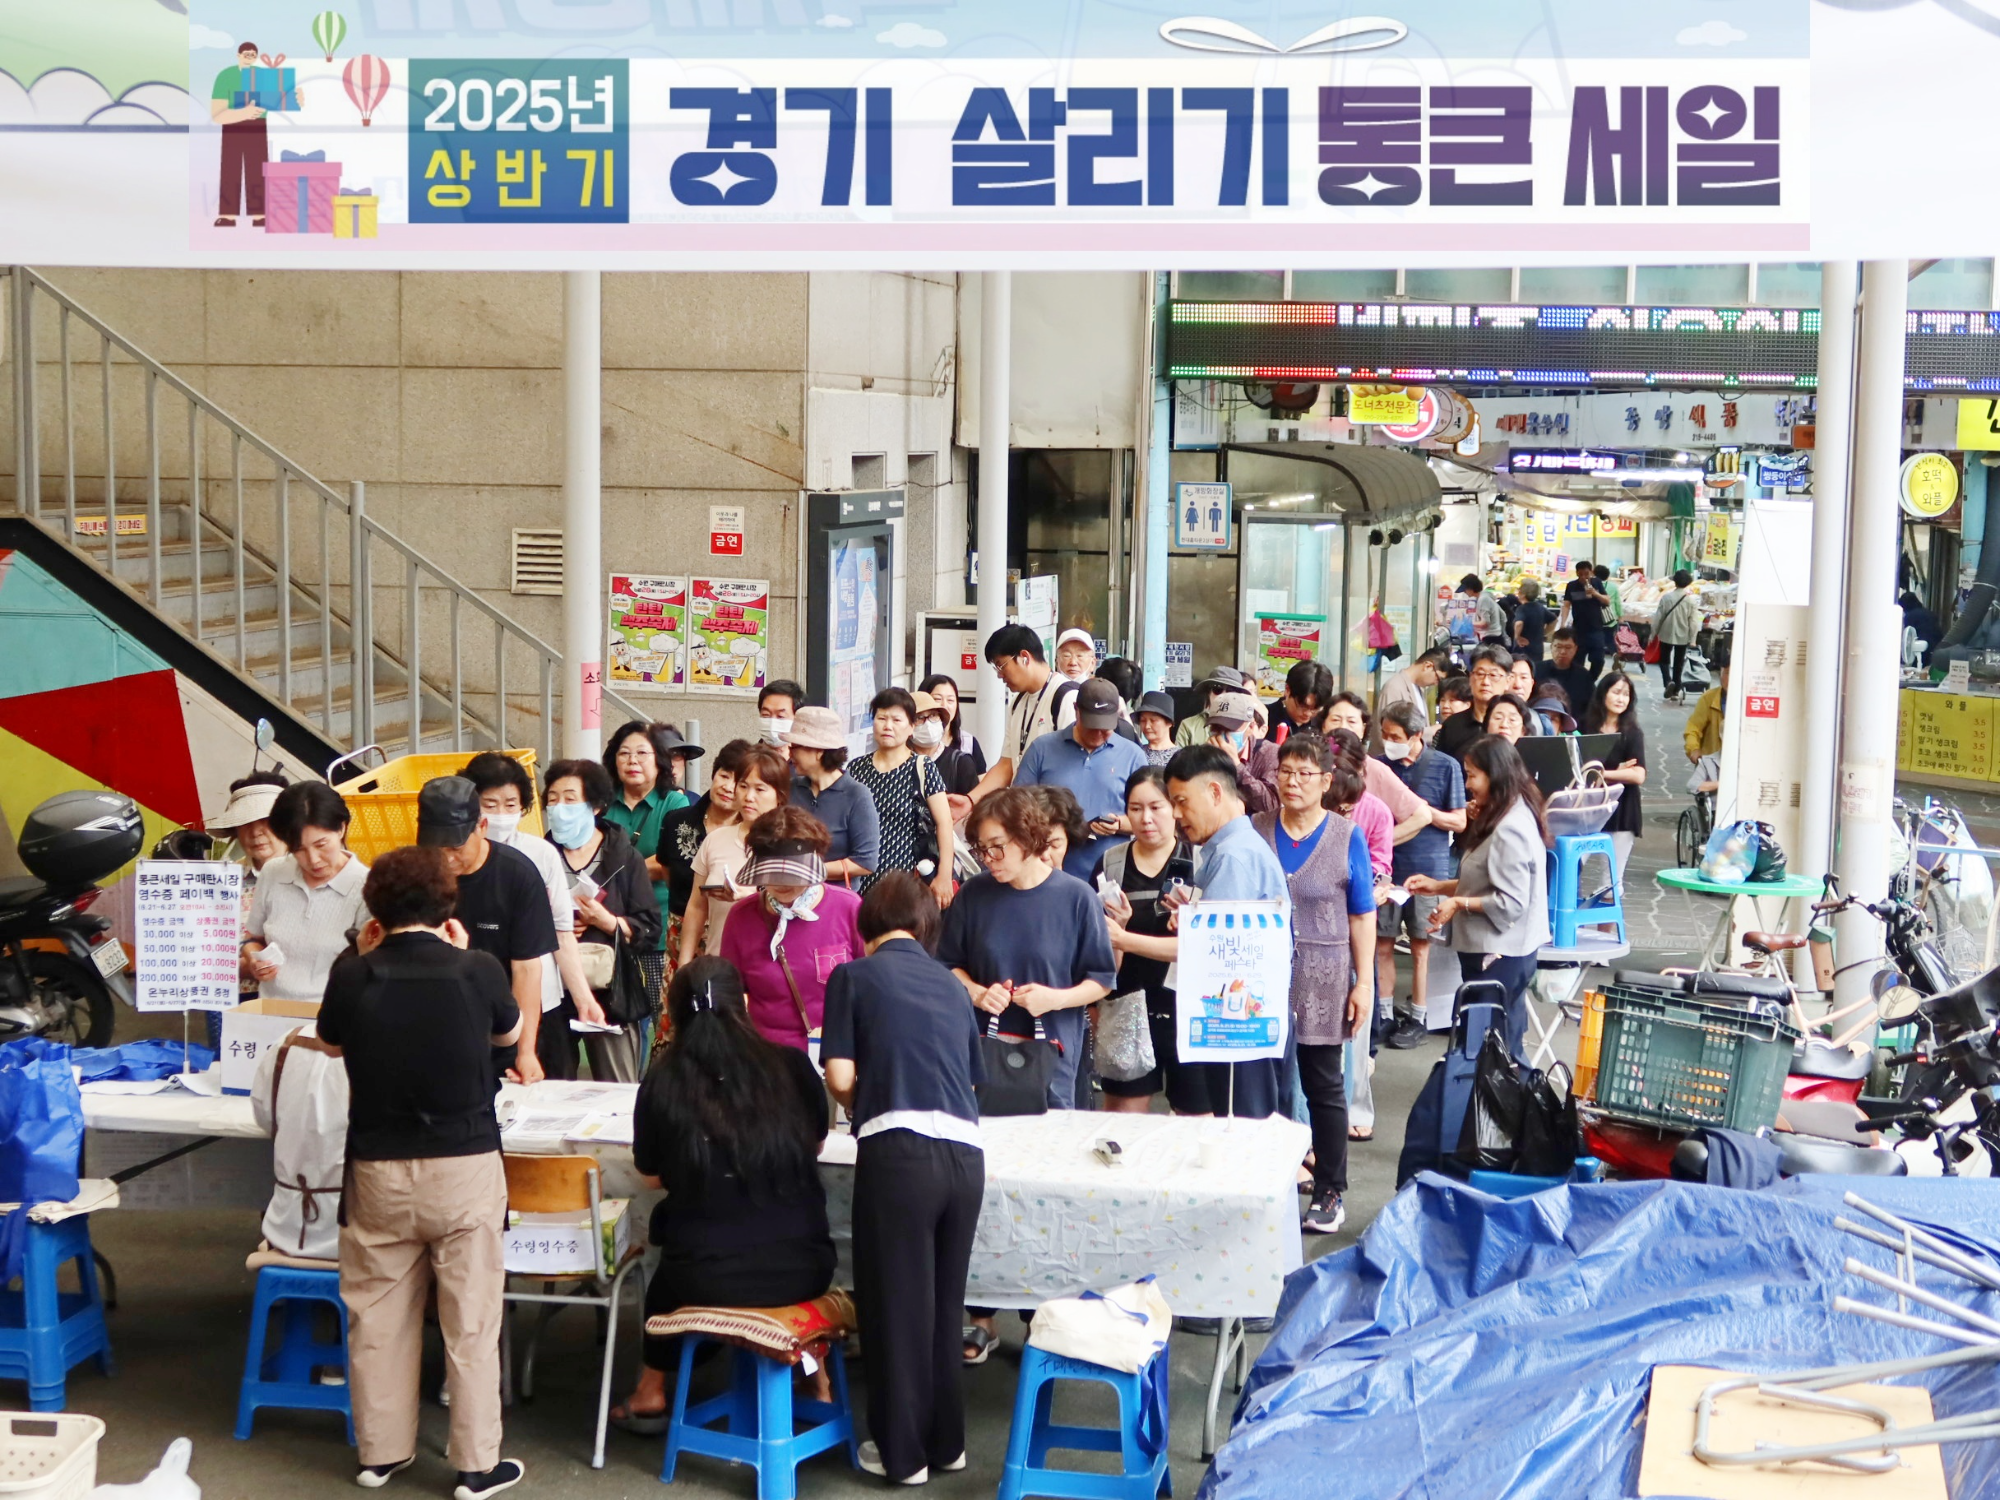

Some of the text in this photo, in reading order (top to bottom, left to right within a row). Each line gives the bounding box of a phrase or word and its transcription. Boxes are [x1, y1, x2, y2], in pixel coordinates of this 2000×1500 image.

[424, 76, 613, 133] 2025년
[669, 85, 1780, 206] 경기 살리기 통큰 세일
[425, 149, 613, 208] 상반기
[1353, 400, 1416, 414] 도너츠전문점
[1922, 469, 1942, 483] 호떡
[1922, 491, 1942, 506] 와플
[715, 535, 738, 547] 금연
[634, 601, 663, 615] 탄탄
[715, 605, 744, 619] 탄탄
[620, 615, 678, 631] 맥주축제
[700, 618, 760, 635] 맥주축제
[1750, 698, 1775, 711] 금연
[1919, 712, 1986, 726] 옛날 3.5
[1919, 724, 1985, 739] 생크림 3.5
[1918, 735, 1985, 751] 딸기 생크림 3.5
[1918, 748, 1985, 763] 초코 생크림 3.5
[1938, 762, 1952, 772] 빠진
[1954, 763, 1967, 774] 딸기
[1971, 766, 1984, 775] 4.0
[138, 873, 239, 886] 통큰세일 구매탄시장
[138, 888, 239, 901] 영수증 페이백 행사
[142, 917, 236, 925] 영수증 금액 상품권 금액
[143, 929, 236, 939] 30,000 이상 5,000원
[1209, 934, 1224, 942] 수원
[143, 944, 237, 954] 50,000 이상 10,000원
[1208, 935, 1264, 960] 새빛 세일
[140, 958, 237, 968] 100,000 이상 20,000원
[1224, 957, 1257, 971] 페스타
[139, 973, 237, 983] 200,000 이상 30,000원
[148, 986, 230, 998] 온누리상품권 증정
[228, 1040, 257, 1059] 수령
